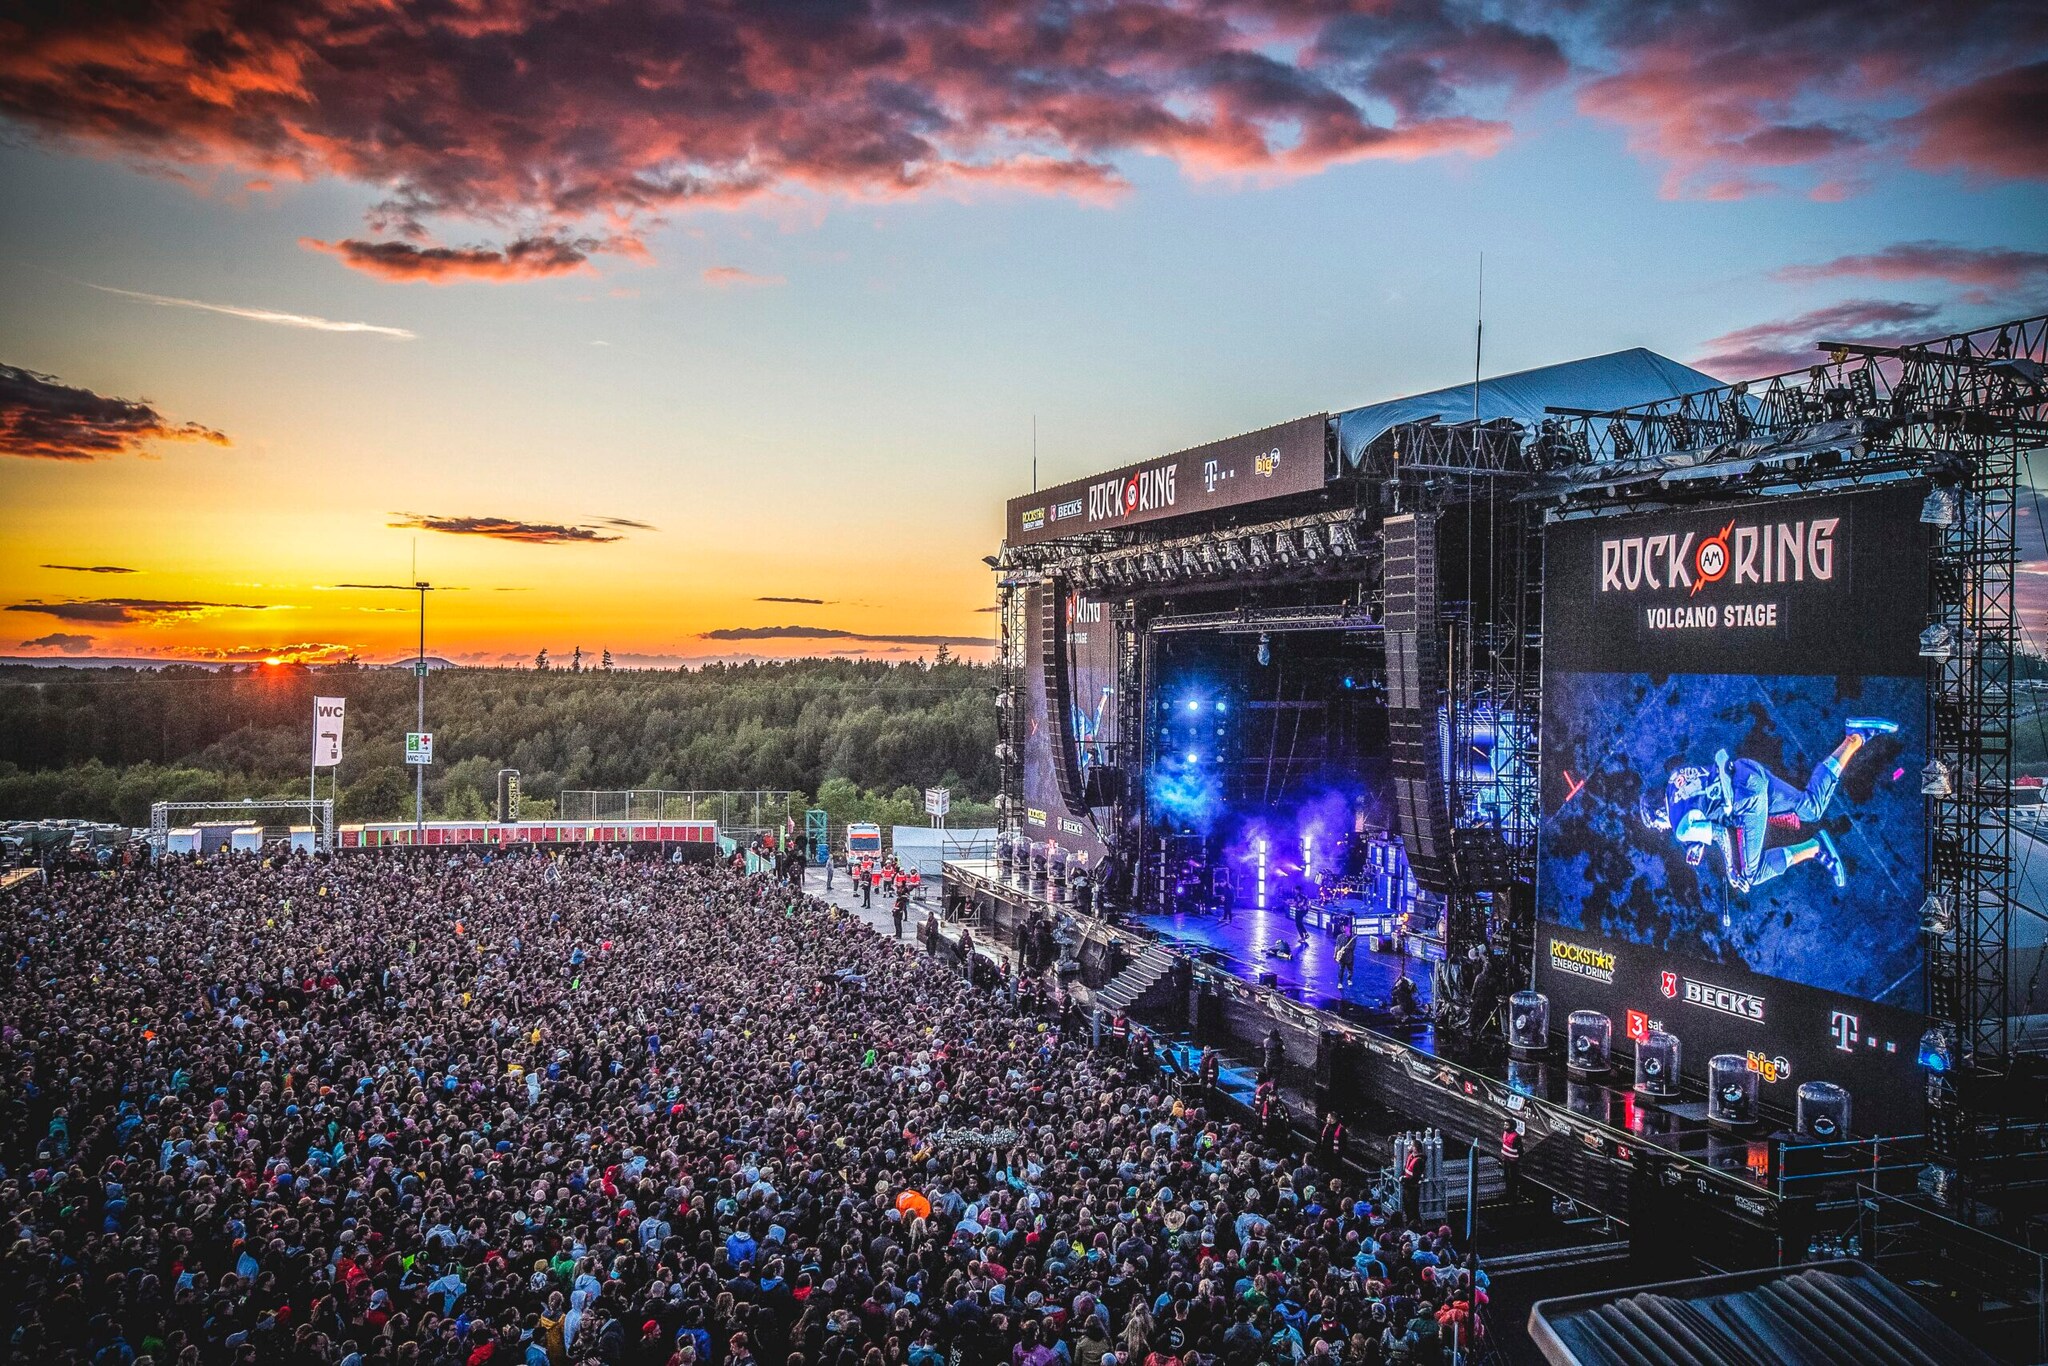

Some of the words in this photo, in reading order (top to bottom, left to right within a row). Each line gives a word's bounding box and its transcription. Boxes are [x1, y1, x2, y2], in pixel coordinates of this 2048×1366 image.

[1088, 477, 1125, 522] ROCK
[1140, 464, 1177, 511] RING
[1058, 500, 1082, 518] BECK'S
[1602, 532, 1695, 592] ROCK
[1702, 551, 1722, 568] AM
[1734, 518, 1840, 584] RING
[1647, 606, 1717, 628] VOLCANO
[1724, 604, 1777, 627] STAGE
[318, 706, 343, 717] WC
[1550, 939, 1616, 971] ROCKSTAR
[1553, 957, 1584, 973] ENERGY
[1585, 965, 1612, 981] DRINK
[1685, 981, 1763, 1018] BECK'S
